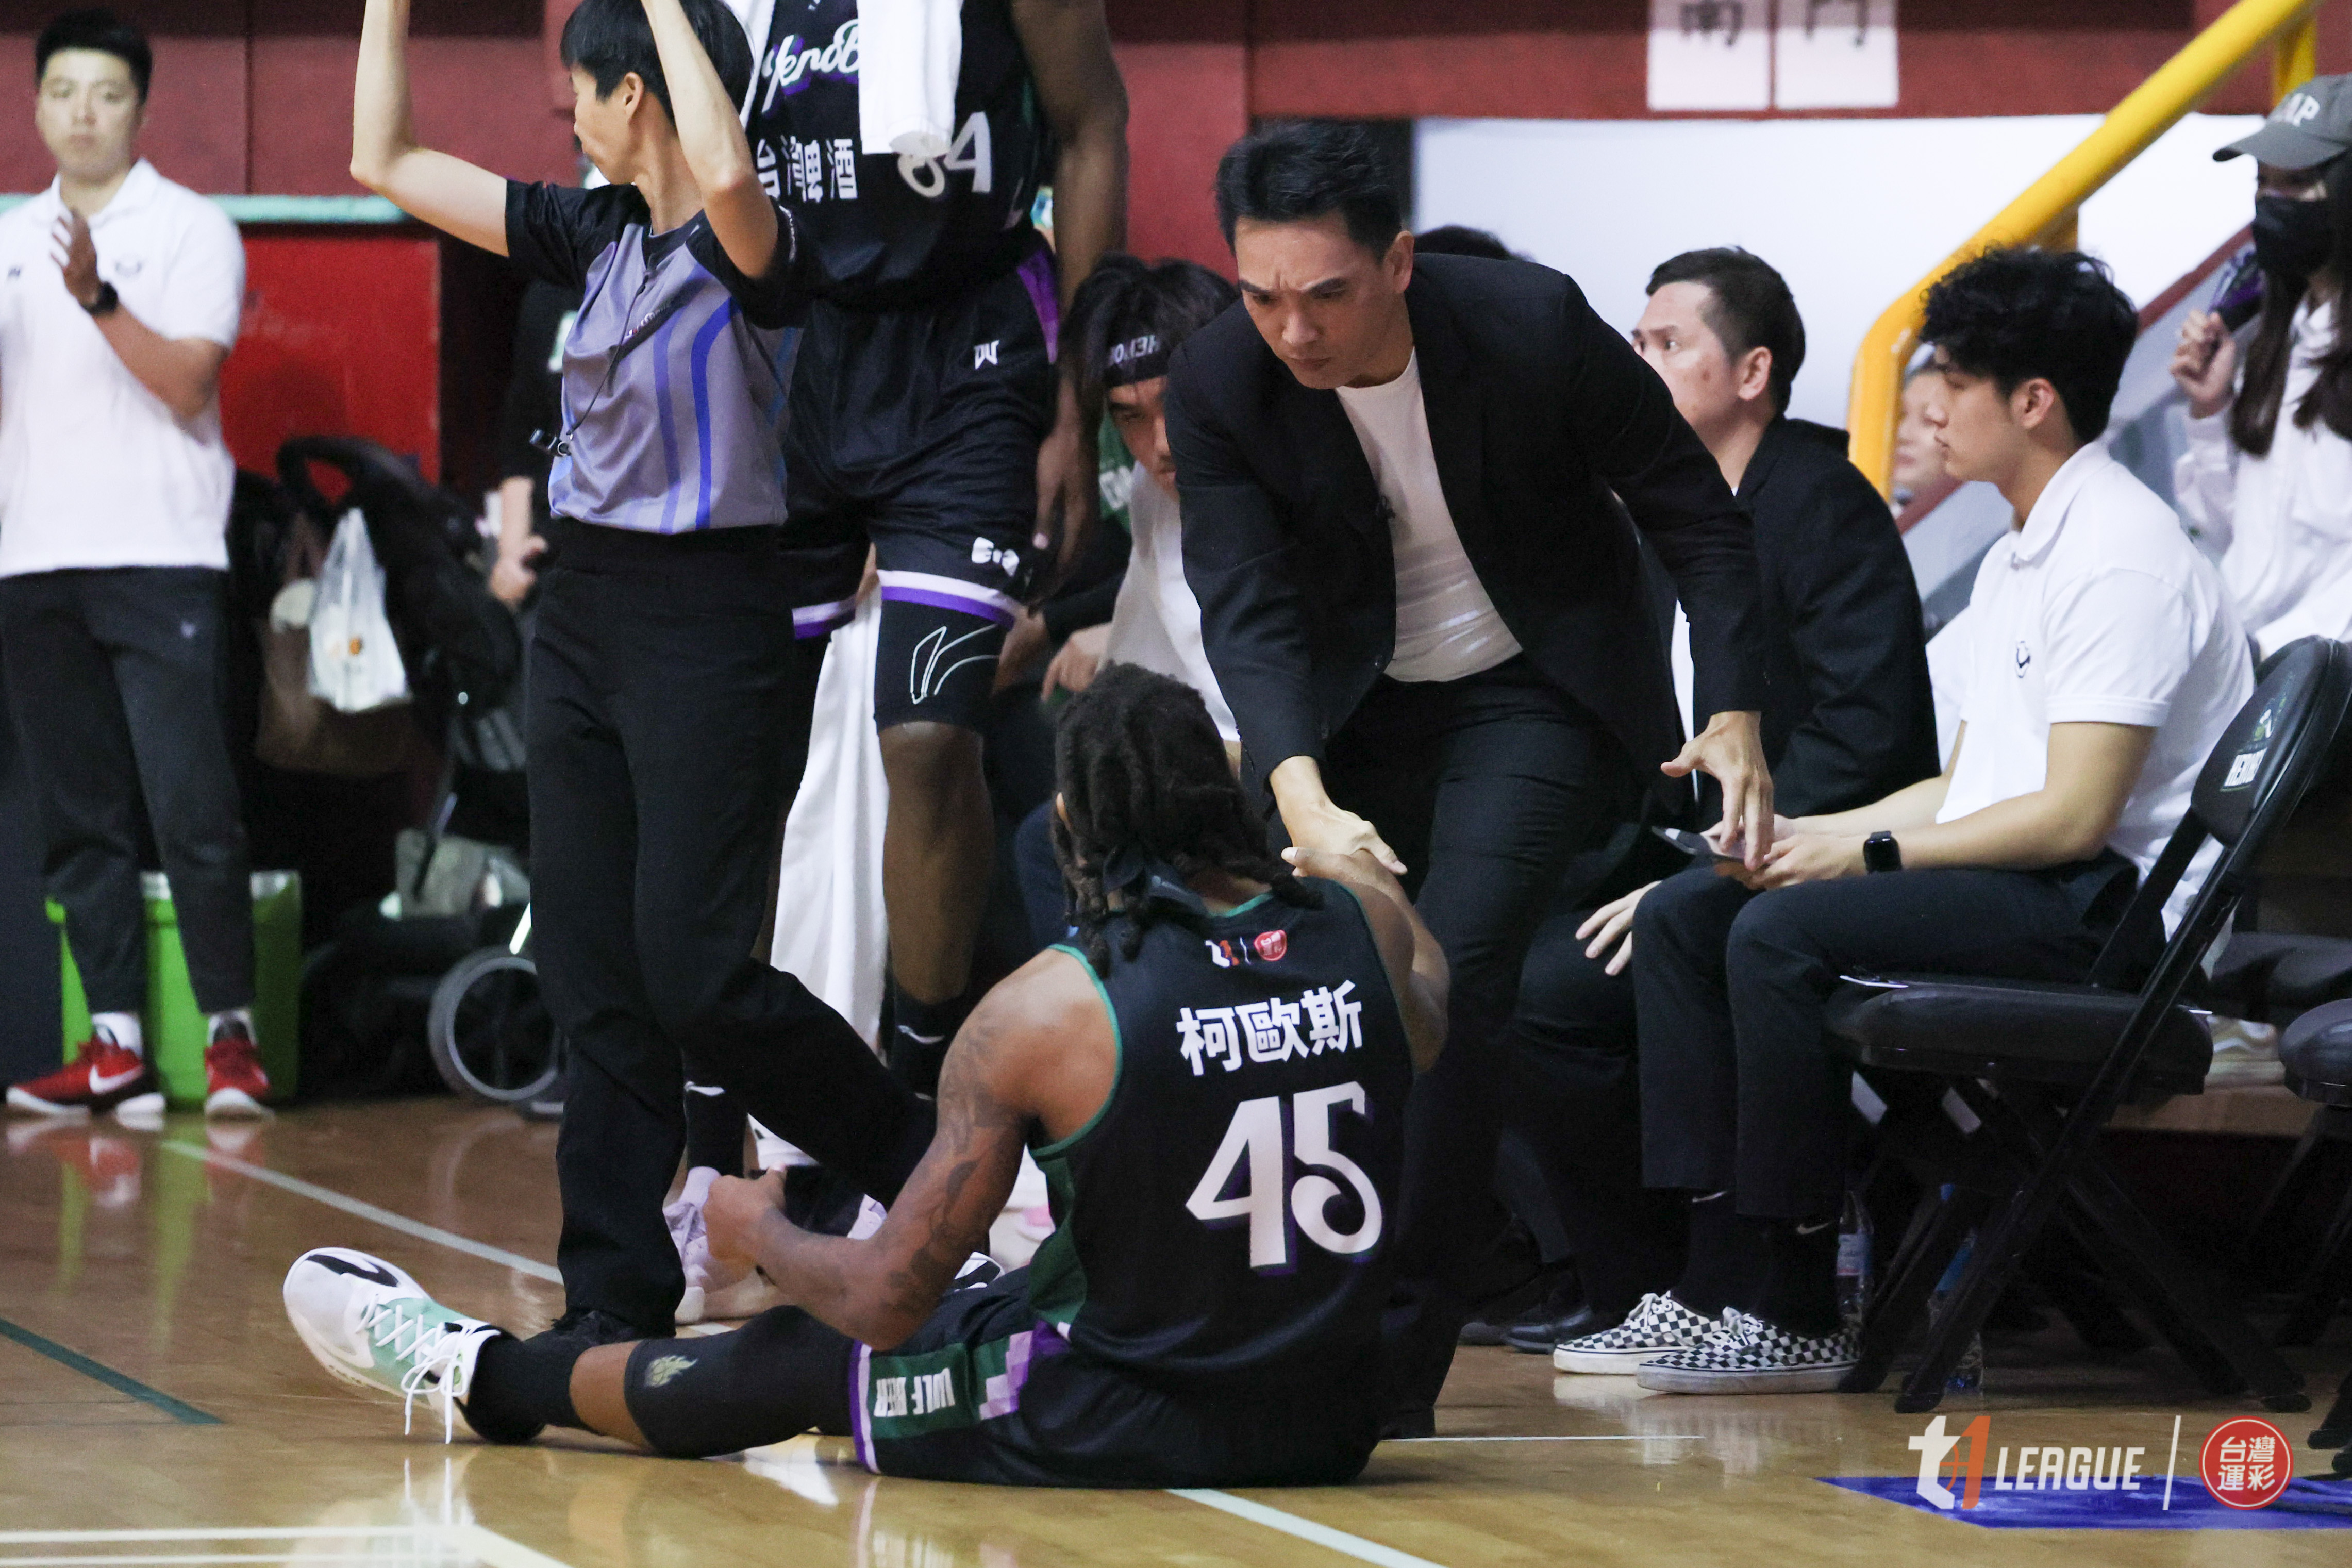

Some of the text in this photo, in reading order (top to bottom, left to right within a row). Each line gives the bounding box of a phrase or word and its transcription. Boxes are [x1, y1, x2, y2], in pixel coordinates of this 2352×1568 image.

[1176, 979, 1363, 1076] 柯歐斯
[1186, 1081, 1383, 1268] 45
